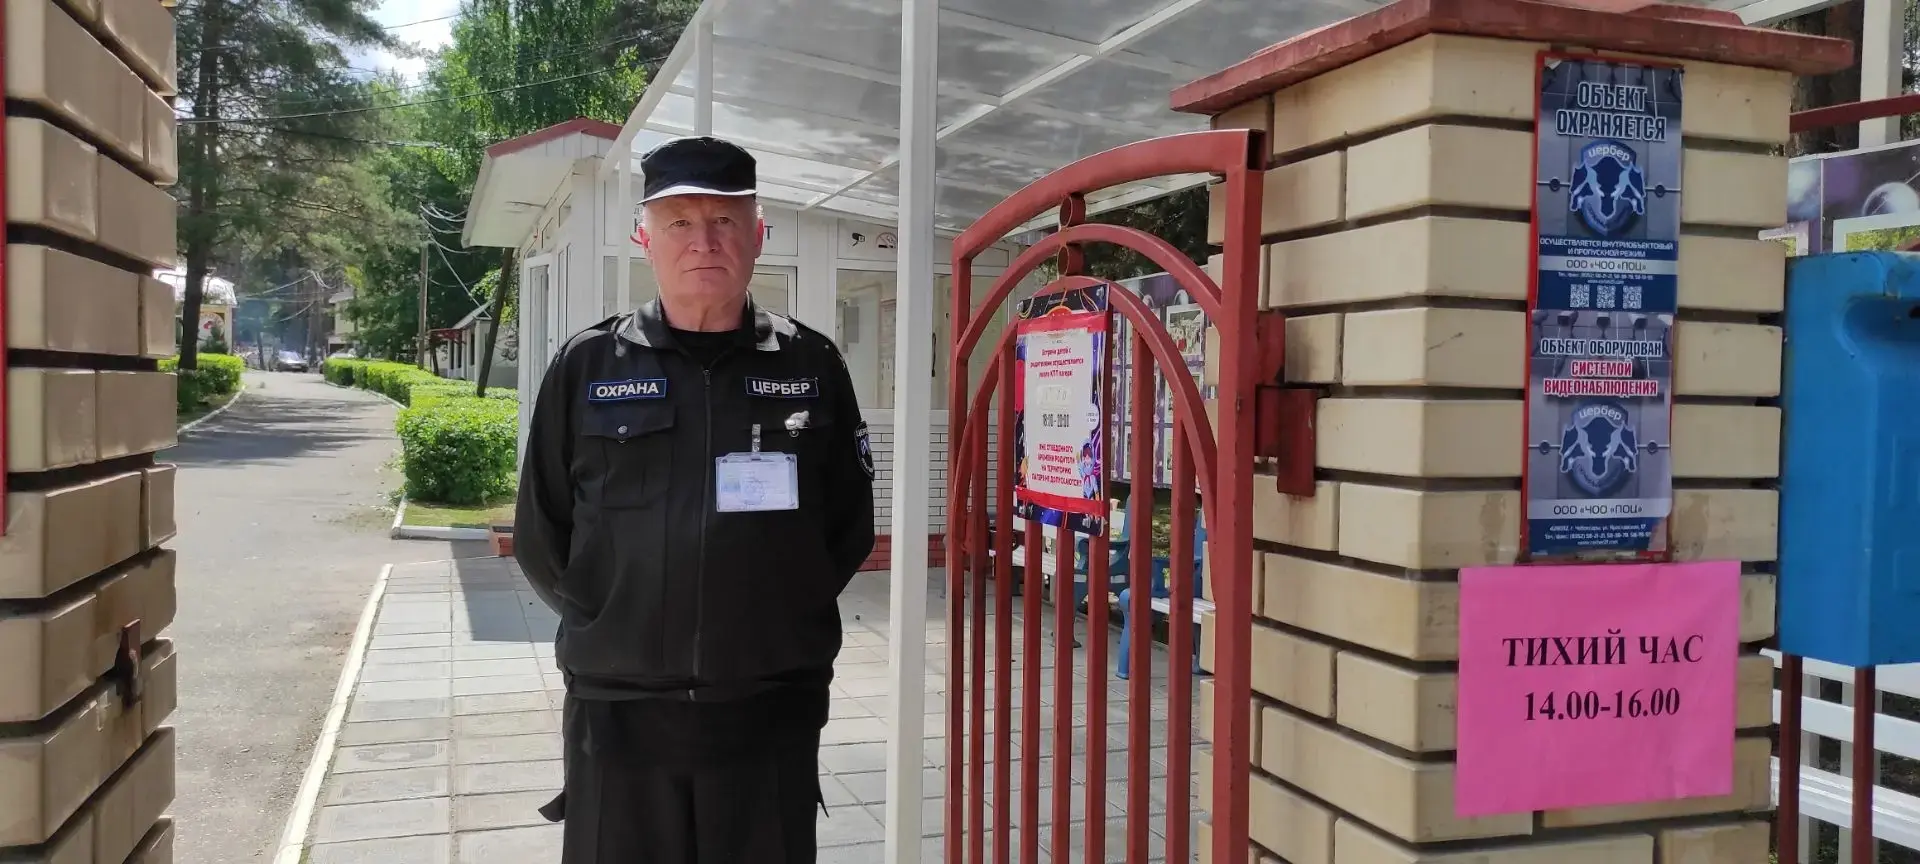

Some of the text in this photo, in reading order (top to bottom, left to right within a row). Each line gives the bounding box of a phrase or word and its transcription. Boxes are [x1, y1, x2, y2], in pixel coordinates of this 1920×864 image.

[1577, 82, 1647, 112] ОБЪЕКТ
[1556, 112, 1667, 142] ОХРАНЯЕТСЯ
[1588, 144, 1631, 162] цербер
[1540, 238, 1673, 250] ОСУЩЕСТВЛЯЕТСЯ ВНУТРИОБЪЕКТОВЫЙ
[1574, 249, 1619, 257] ПРОПУСКНОЙ
[1620, 250, 1646, 258] РЕЖИМ
[1566, 259, 1588, 269] ООО
[1540, 338, 1663, 358] ОБЪЕКТ ОБОРУДОВАН
[1571, 358, 1633, 378] СИСТЕМОЙ
[596, 381, 659, 398] ОХРАНА
[751, 379, 811, 396] ЦЕРБЕР
[1543, 379, 1658, 397] ВИДЕОНАБЛЮДЕНИЯ
[1579, 404, 1623, 422] цербер
[1553, 505, 1578, 515] ООО
[1502, 629, 1704, 667] ТИХИЙ ЧАС
[1524, 687, 1681, 721] 14.00-16.00
